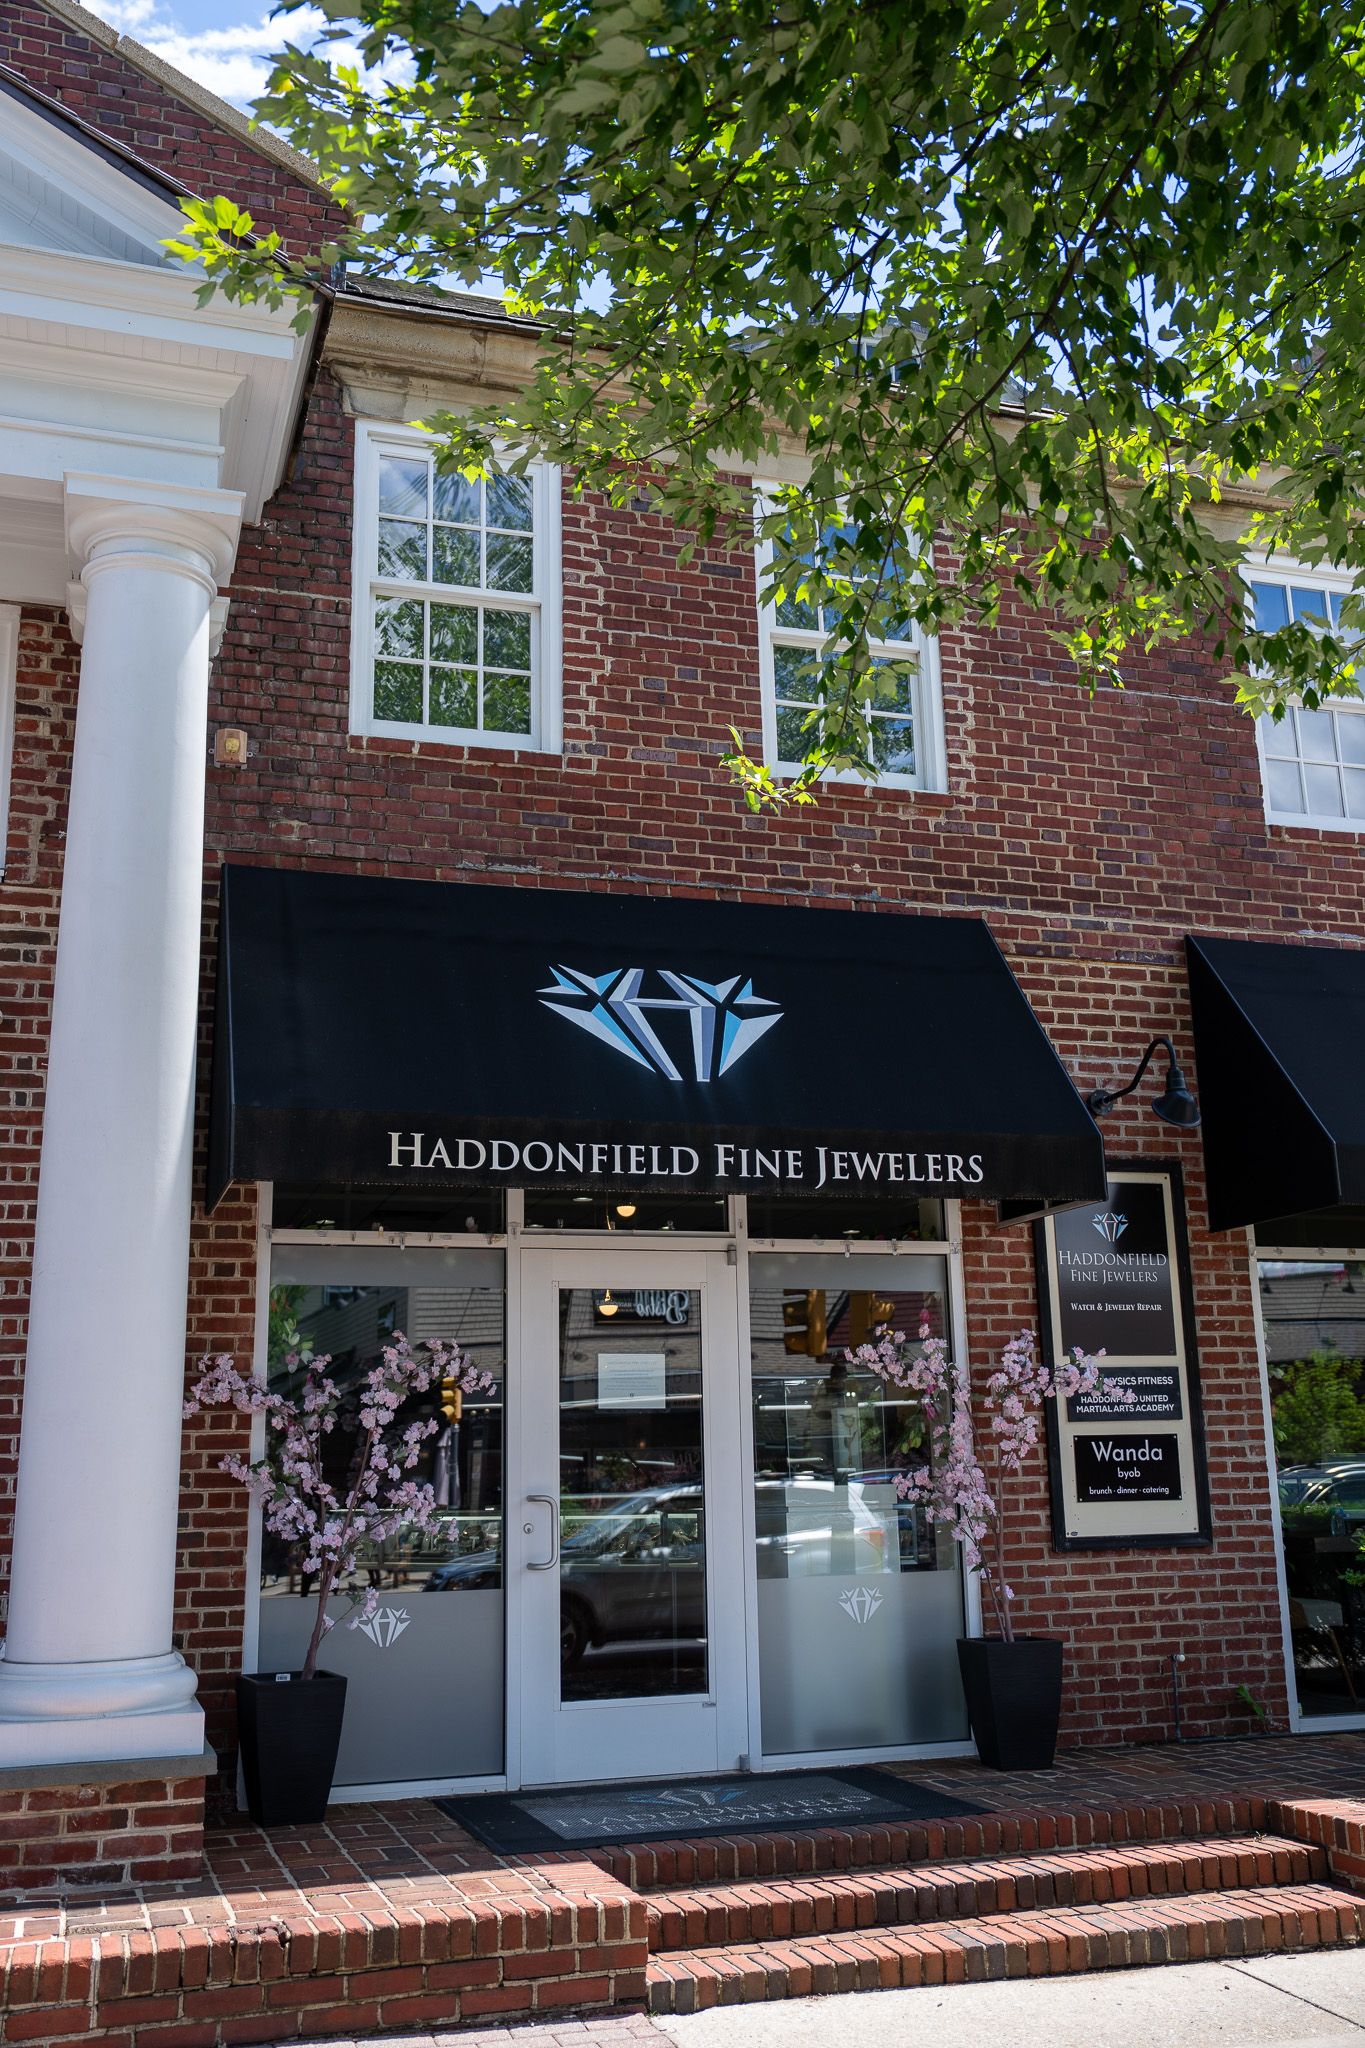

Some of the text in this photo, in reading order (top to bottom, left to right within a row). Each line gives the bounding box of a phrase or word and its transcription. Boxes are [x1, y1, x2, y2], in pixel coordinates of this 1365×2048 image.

[388, 1131, 984, 1189] HADDONFIELD FINE JEWELERS
[1059, 1250, 1167, 1266] HADDONFIELD
[1071, 1269, 1158, 1285] FINE JEWELERS
[1070, 1302, 1162, 1312] WATCH & JEWELRY REPAIR
[1138, 1376, 1174, 1385] FITNESS
[1139, 1394, 1169, 1403] UNITED
[1076, 1403, 1175, 1413] MARTIAL ARTS ACADEMY
[1091, 1439, 1163, 1462] Wanda
[1117, 1466, 1141, 1480] byob
[1089, 1485, 1170, 1495] brunch dinner catering
